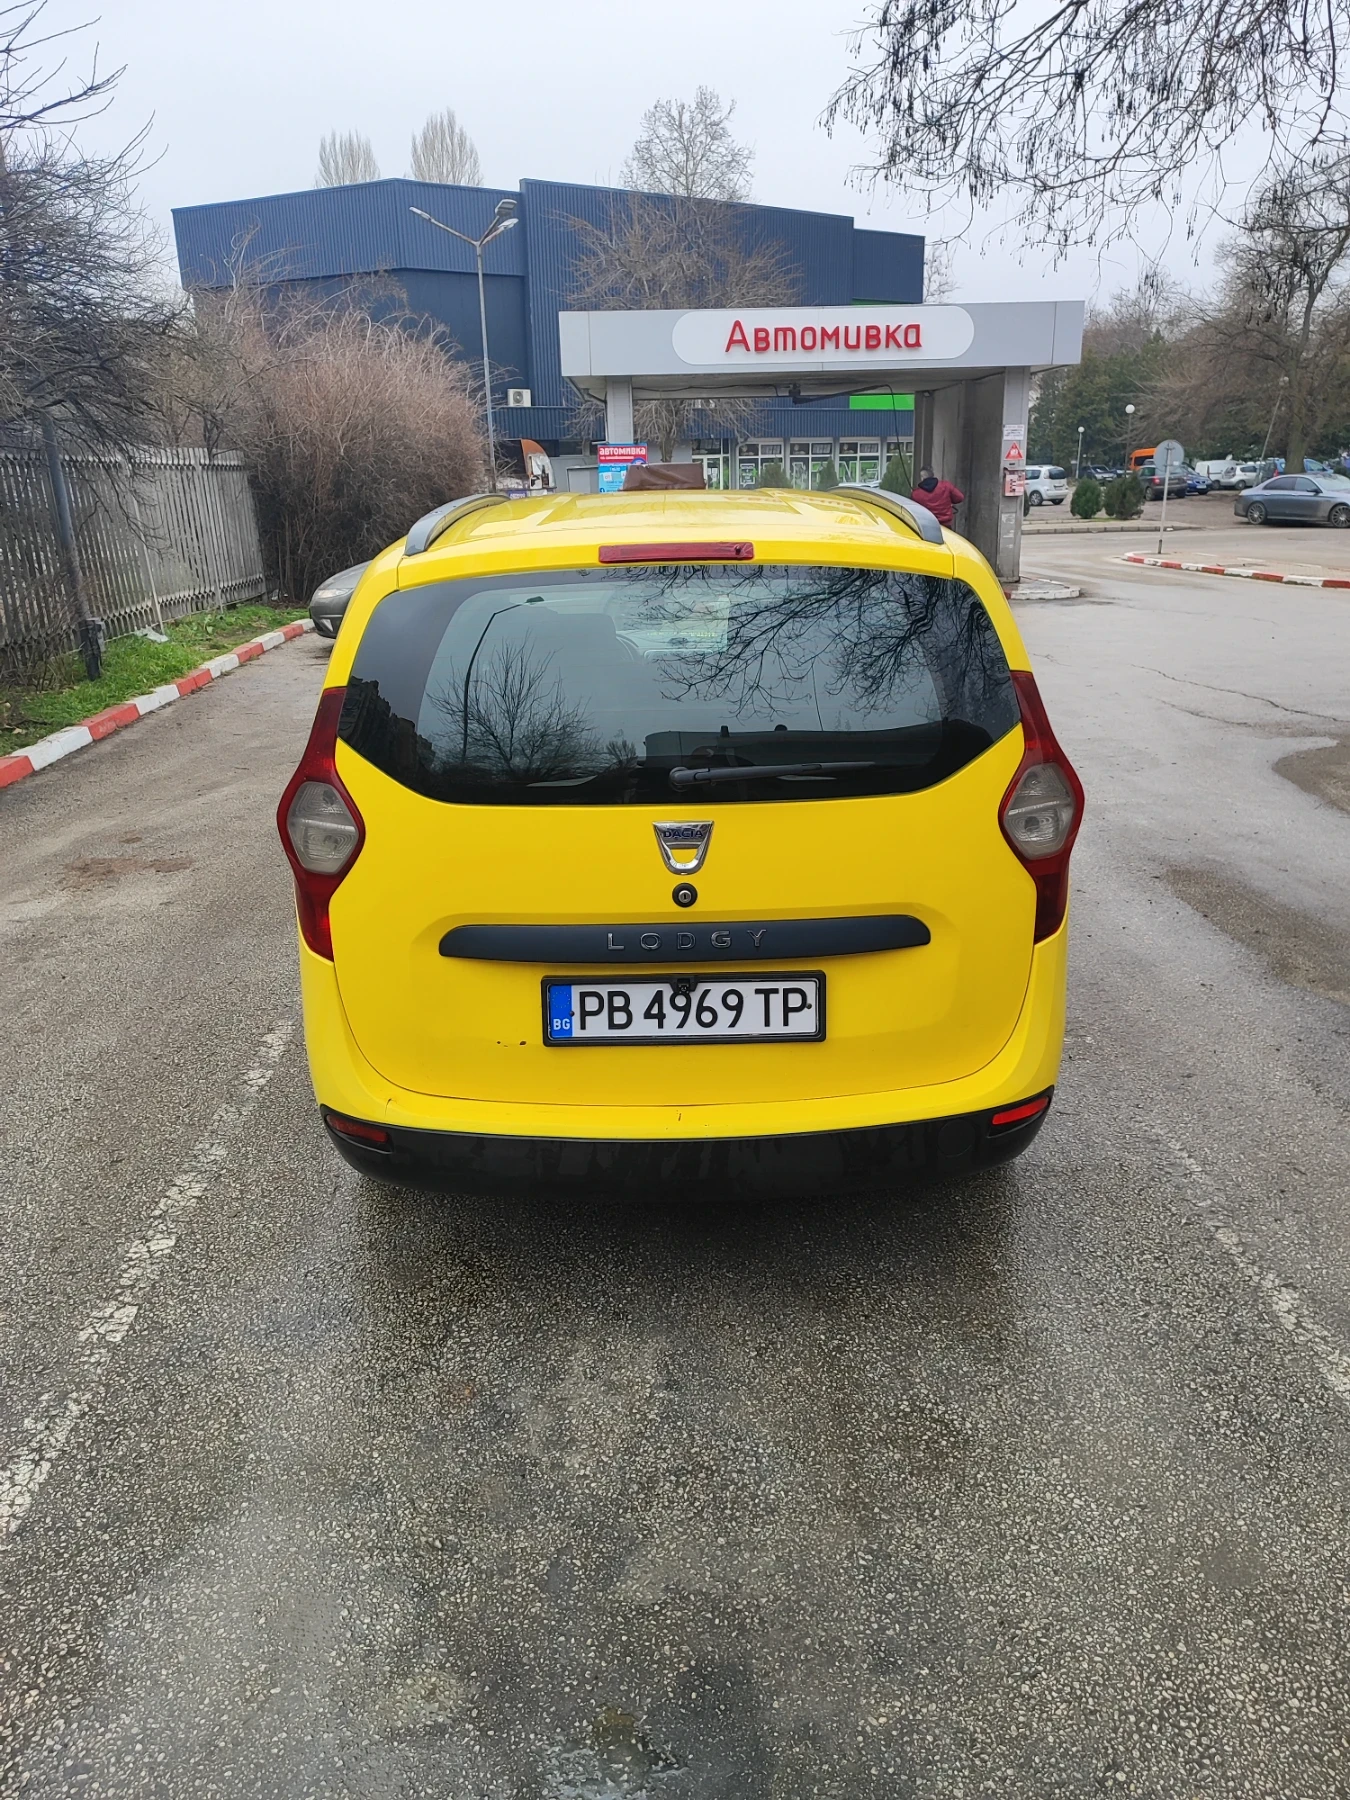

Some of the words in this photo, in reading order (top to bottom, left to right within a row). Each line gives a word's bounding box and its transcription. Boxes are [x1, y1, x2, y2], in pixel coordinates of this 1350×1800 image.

[725, 319, 922, 353] Автомивка
[663, 827, 704, 838] DACIA
[607, 929, 767, 951] LODGY
[643, 988, 744, 1030] 4969
[553, 1018, 571, 1031] BG
